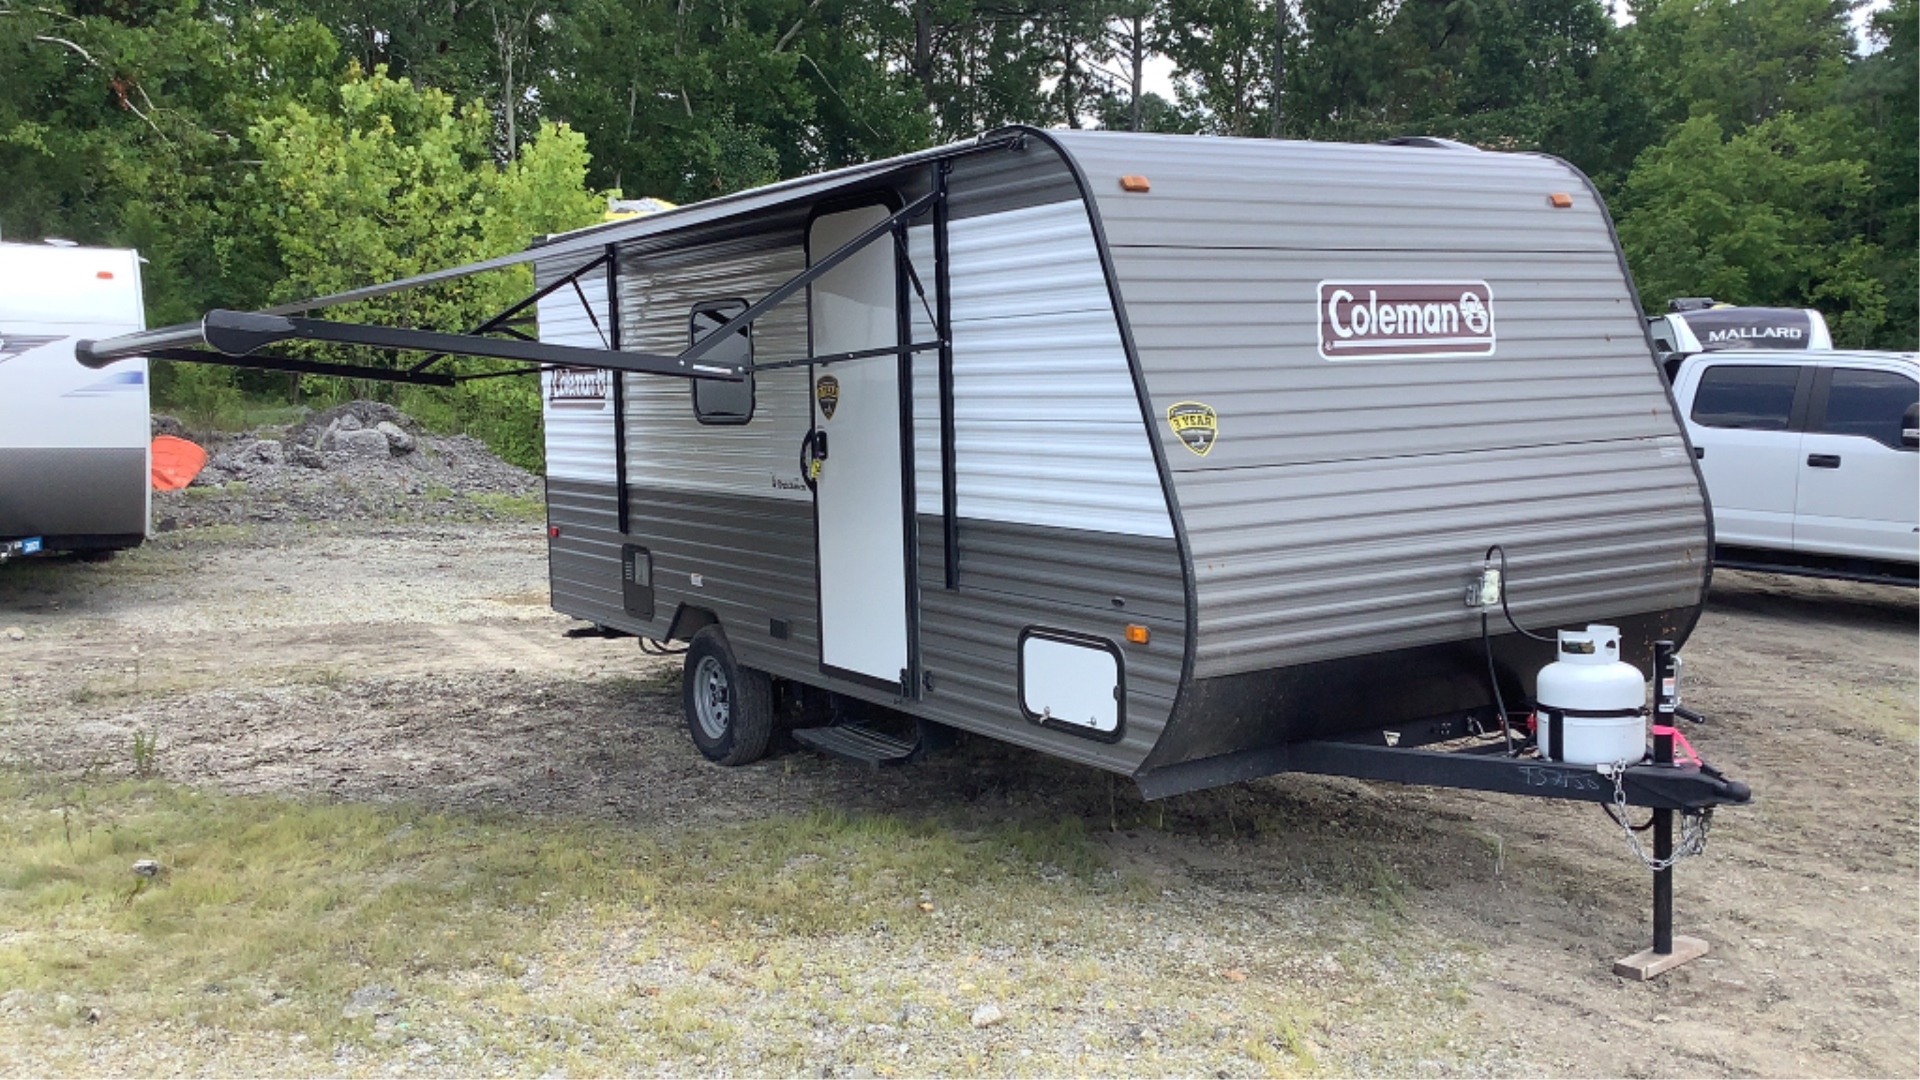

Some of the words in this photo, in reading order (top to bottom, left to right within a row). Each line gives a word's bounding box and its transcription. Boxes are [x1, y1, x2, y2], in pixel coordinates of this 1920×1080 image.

[1328, 289, 1459, 338] Coleman
[1708, 326, 1803, 343] MALLARD
[1173, 418, 1182, 430] 3
[1182, 415, 1212, 426] YEAR
